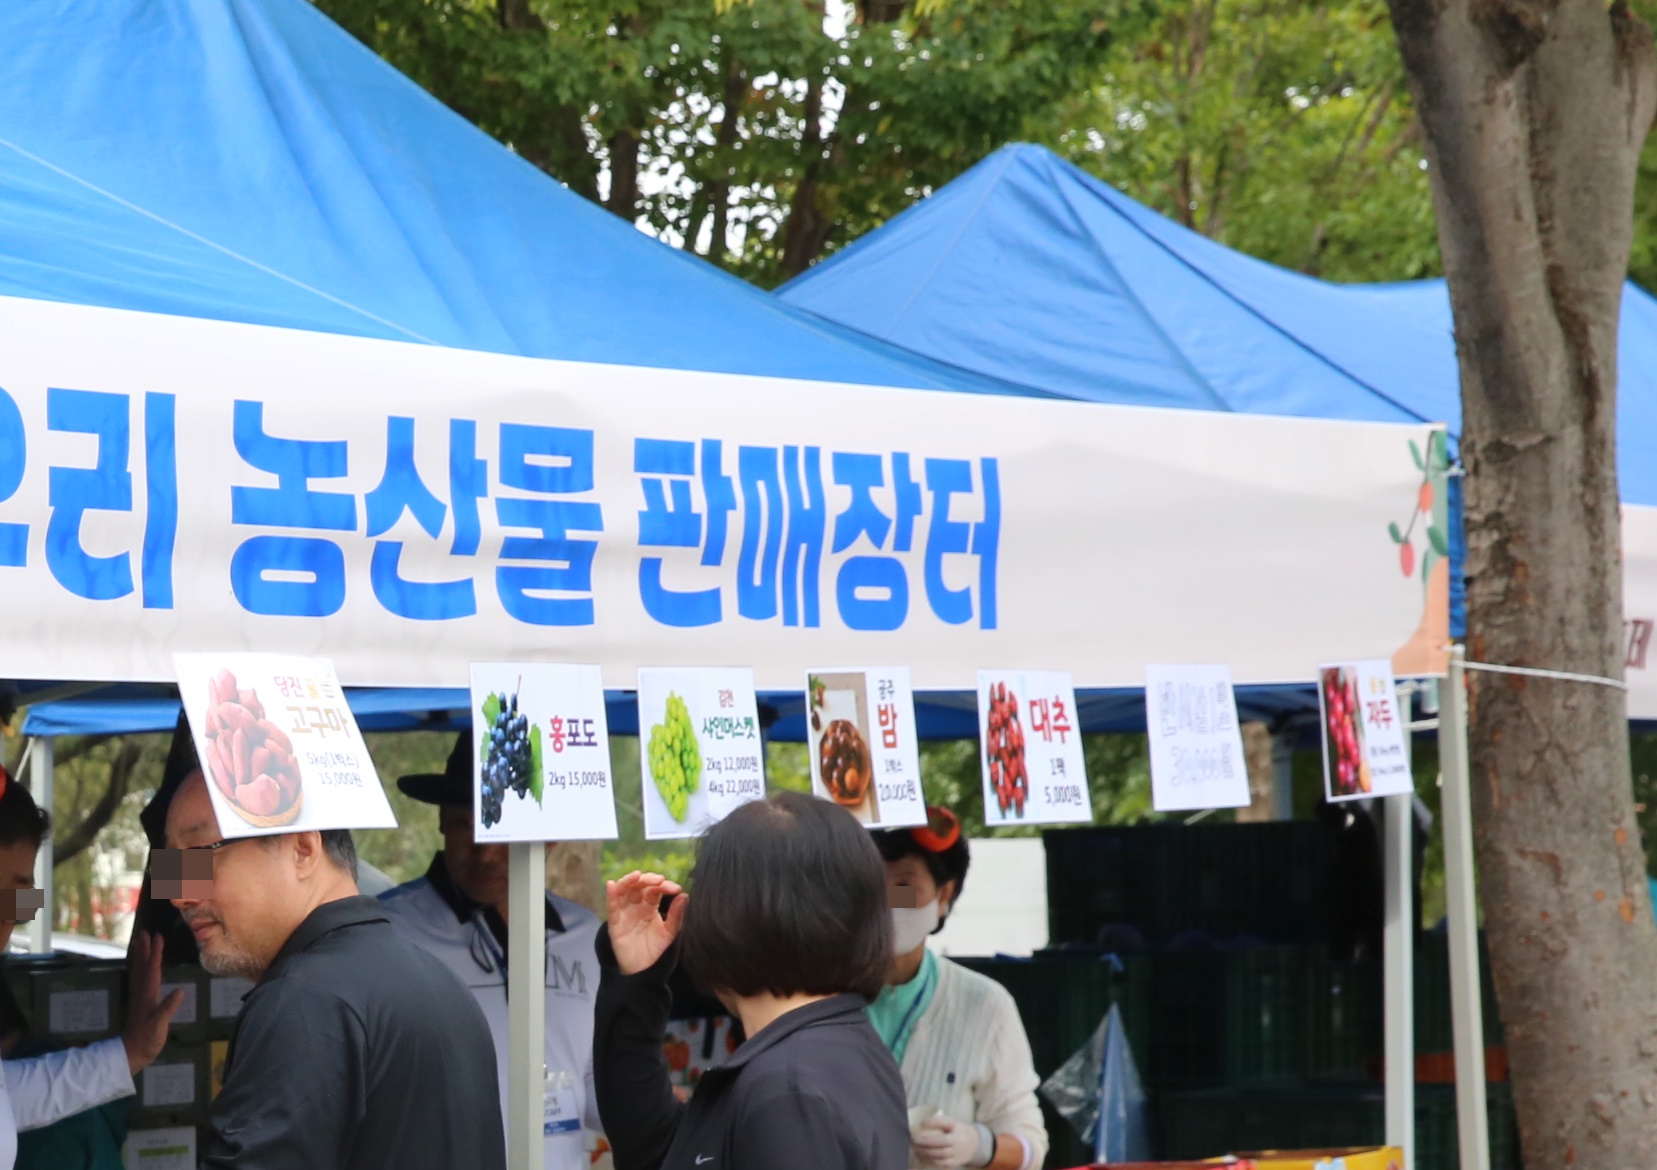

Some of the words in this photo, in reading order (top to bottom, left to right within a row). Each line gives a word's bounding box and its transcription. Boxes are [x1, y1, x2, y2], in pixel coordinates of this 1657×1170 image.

[230, 399, 604, 626] 농산물
[633, 435, 1002, 631] 판매장터
[274, 675, 305, 698] 당진
[285, 706, 351, 739] 고구마
[549, 715, 598, 753] 홍포도
[877, 703, 898, 748] 밤
[1029, 695, 1072, 744] 대추
[548, 771, 566, 789] 2kg
[568, 770, 607, 788] 15,000원
